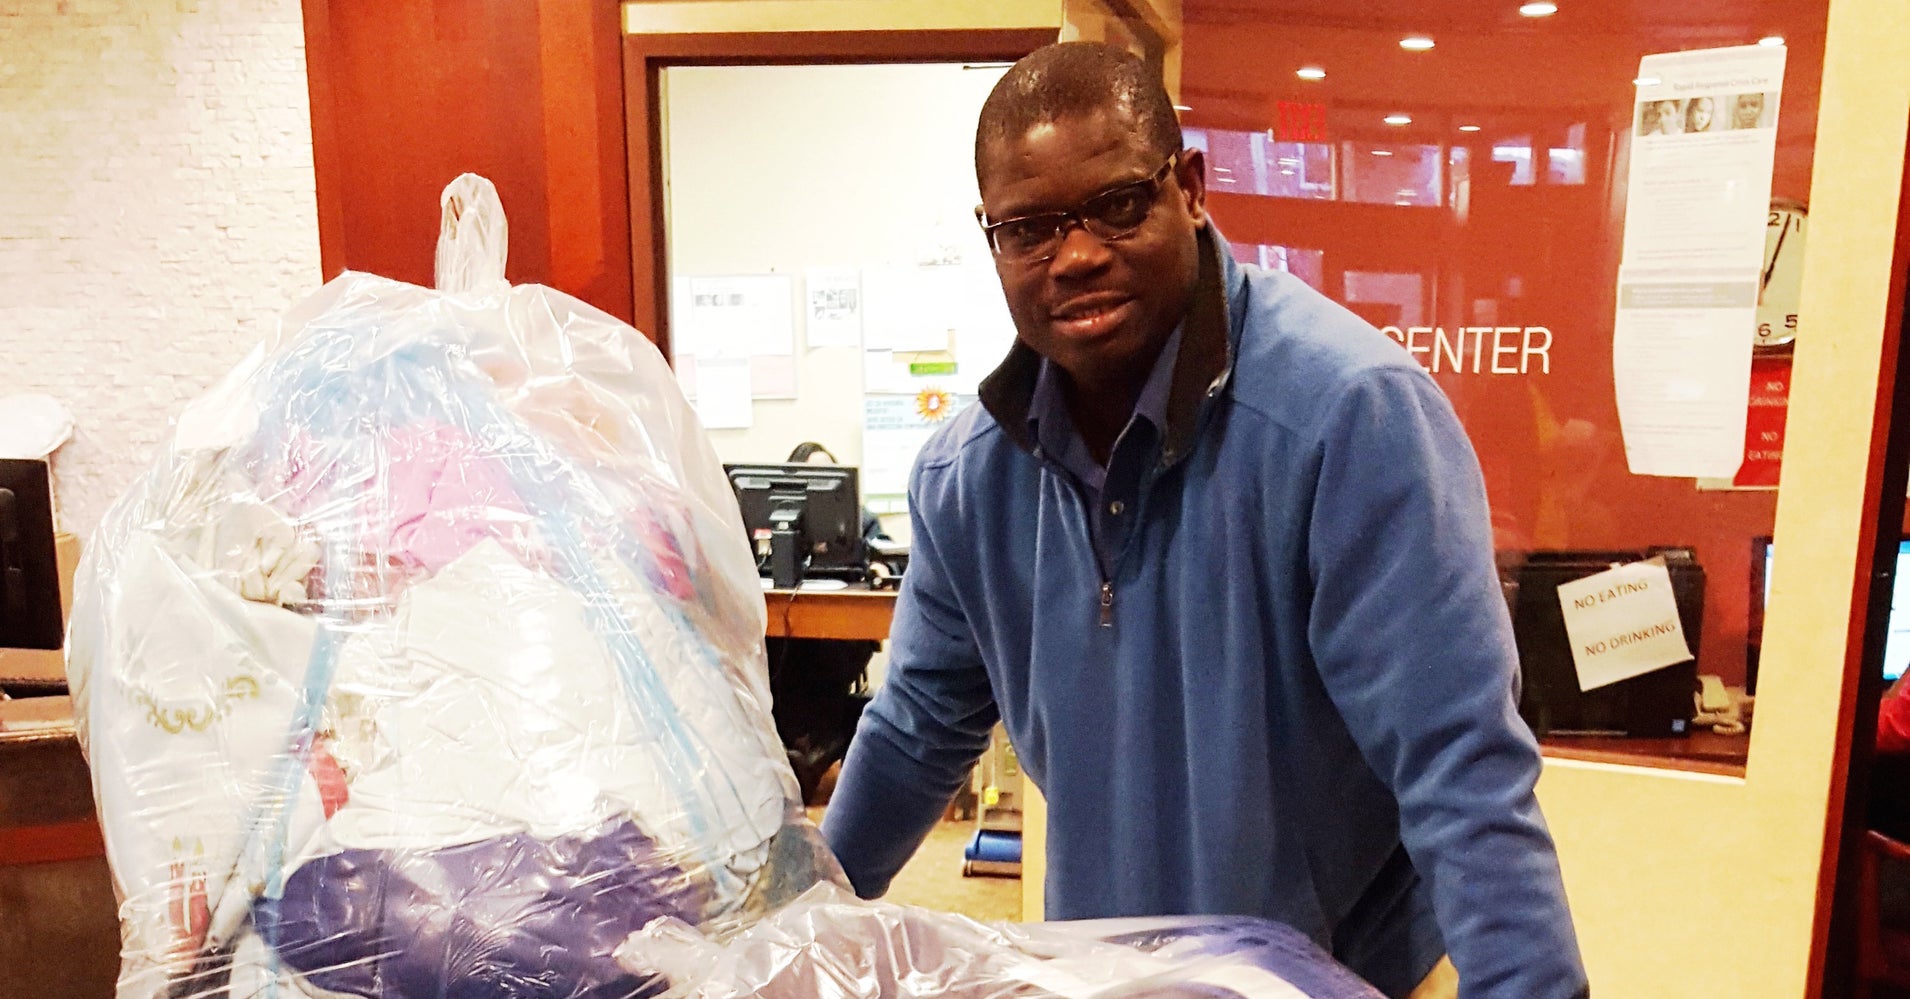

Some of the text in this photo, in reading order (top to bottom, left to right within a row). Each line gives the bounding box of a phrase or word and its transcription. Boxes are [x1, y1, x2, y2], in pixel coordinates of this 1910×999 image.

[1767, 212, 1781, 227] 2
[1785, 314, 1798, 329] 5
[1758, 323, 1771, 337] 6
[1765, 381, 1784, 392] NO
[1760, 431, 1778, 442] NO
[1574, 579, 1648, 610] NO EATING
[1585, 620, 1676, 656] NO DRINKING
